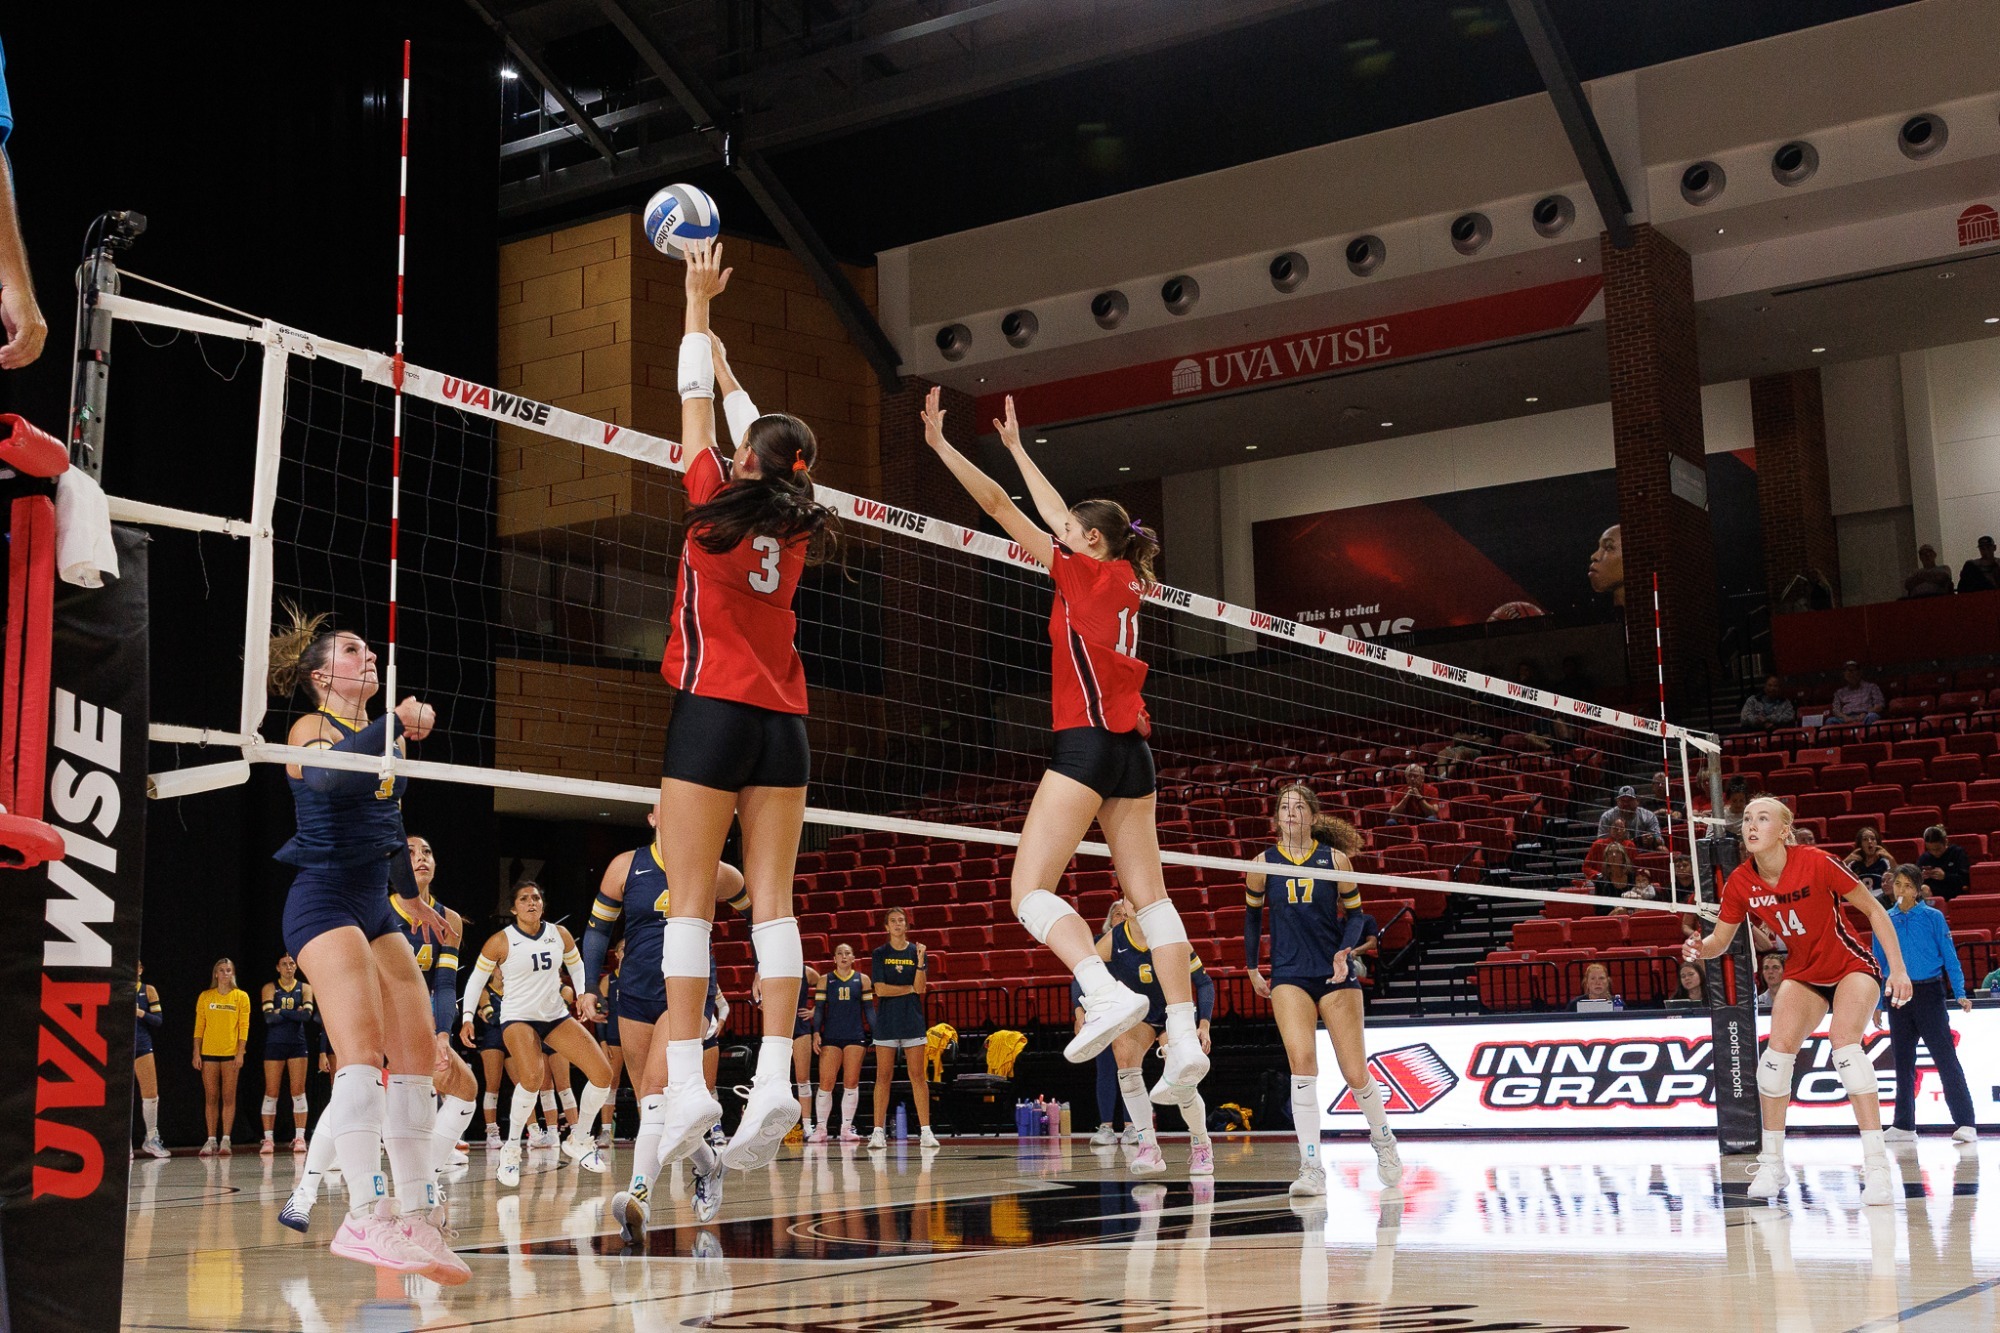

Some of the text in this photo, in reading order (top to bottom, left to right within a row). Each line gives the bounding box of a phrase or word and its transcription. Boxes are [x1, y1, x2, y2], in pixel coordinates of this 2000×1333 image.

[655, 214, 677, 249] molten
[1206, 323, 1393, 388] UVA WISE
[441, 375, 551, 426] UVAWISE
[853, 497, 927, 534] UVAWISE
[1250, 611, 1297, 637] UVAWISE
[1347, 638, 1388, 661] UVAWISE
[1432, 661, 1468, 683] UVAWISE
[1507, 682, 1539, 702] UVAWISE
[1573, 700, 1602, 718] UVAWISE
[1633, 716, 1659, 732] UVAWISE
[748, 535, 780, 594] 3
[1297, 603, 1380, 622] This is what
[1115, 606, 1139, 658] 11
[1286, 878, 1314, 904] 17
[1748, 885, 1811, 909] UVAWISE
[1775, 909, 1806, 936] 14
[32, 687, 122, 1200] UVAWISE
[531, 951, 552, 972] 15
[1138, 963, 1153, 984] 6
[838, 987, 850, 1001] 11
[1728, 1021, 1744, 1098] sports imports
